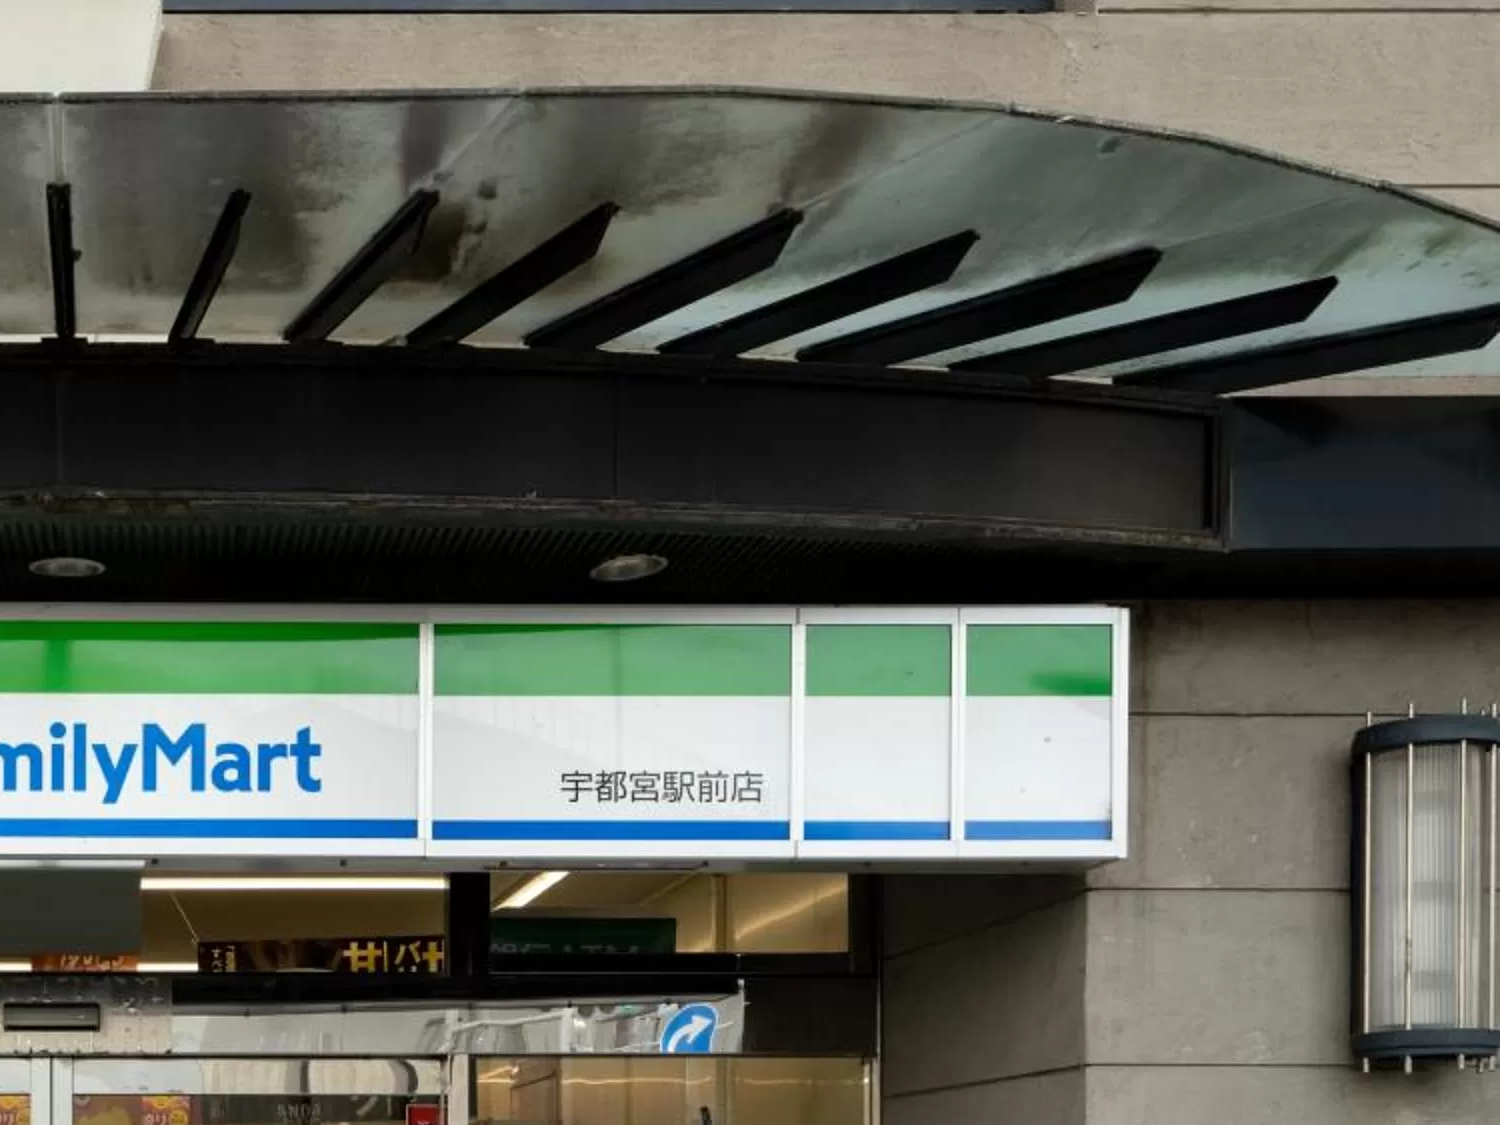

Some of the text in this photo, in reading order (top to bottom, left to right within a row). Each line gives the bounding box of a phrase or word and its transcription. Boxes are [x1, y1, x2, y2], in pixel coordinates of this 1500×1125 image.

[560, 770, 763, 803] 宇都宮駅前店
